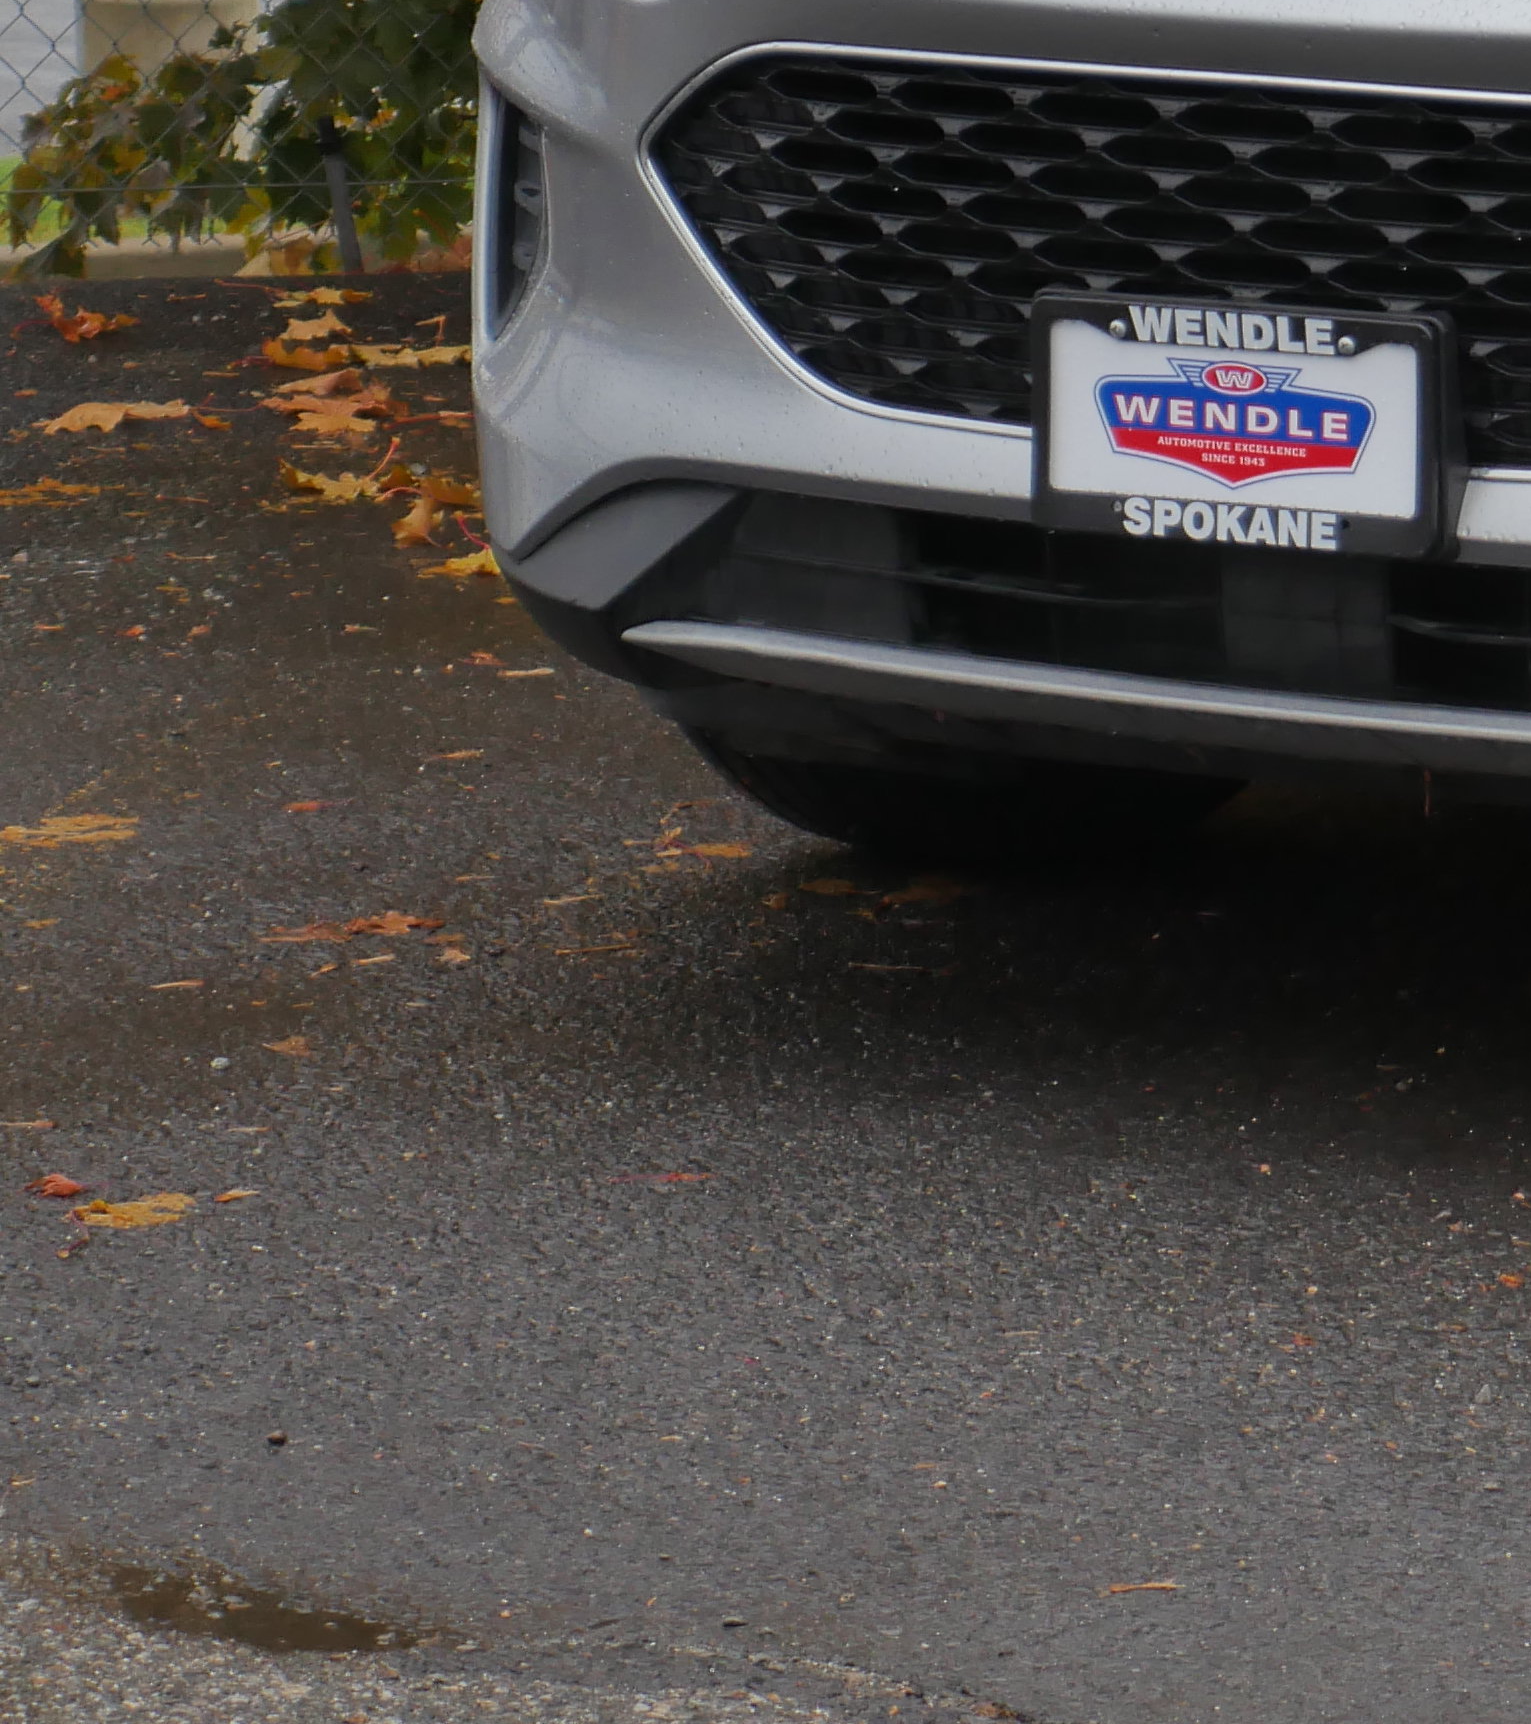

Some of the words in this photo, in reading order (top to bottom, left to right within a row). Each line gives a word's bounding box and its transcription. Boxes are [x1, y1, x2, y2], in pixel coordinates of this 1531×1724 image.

[1128, 304, 1336, 356] WENDLE
[1113, 393, 1349, 440] WENDLE
[1157, 436, 1231, 452] AUTOMOTIVE
[1234, 442, 1307, 458] EXCELLENCE
[1201, 453, 1236, 465] SINCE
[1239, 456, 1266, 467] 1943
[1122, 496, 1338, 551] SPOKANE
